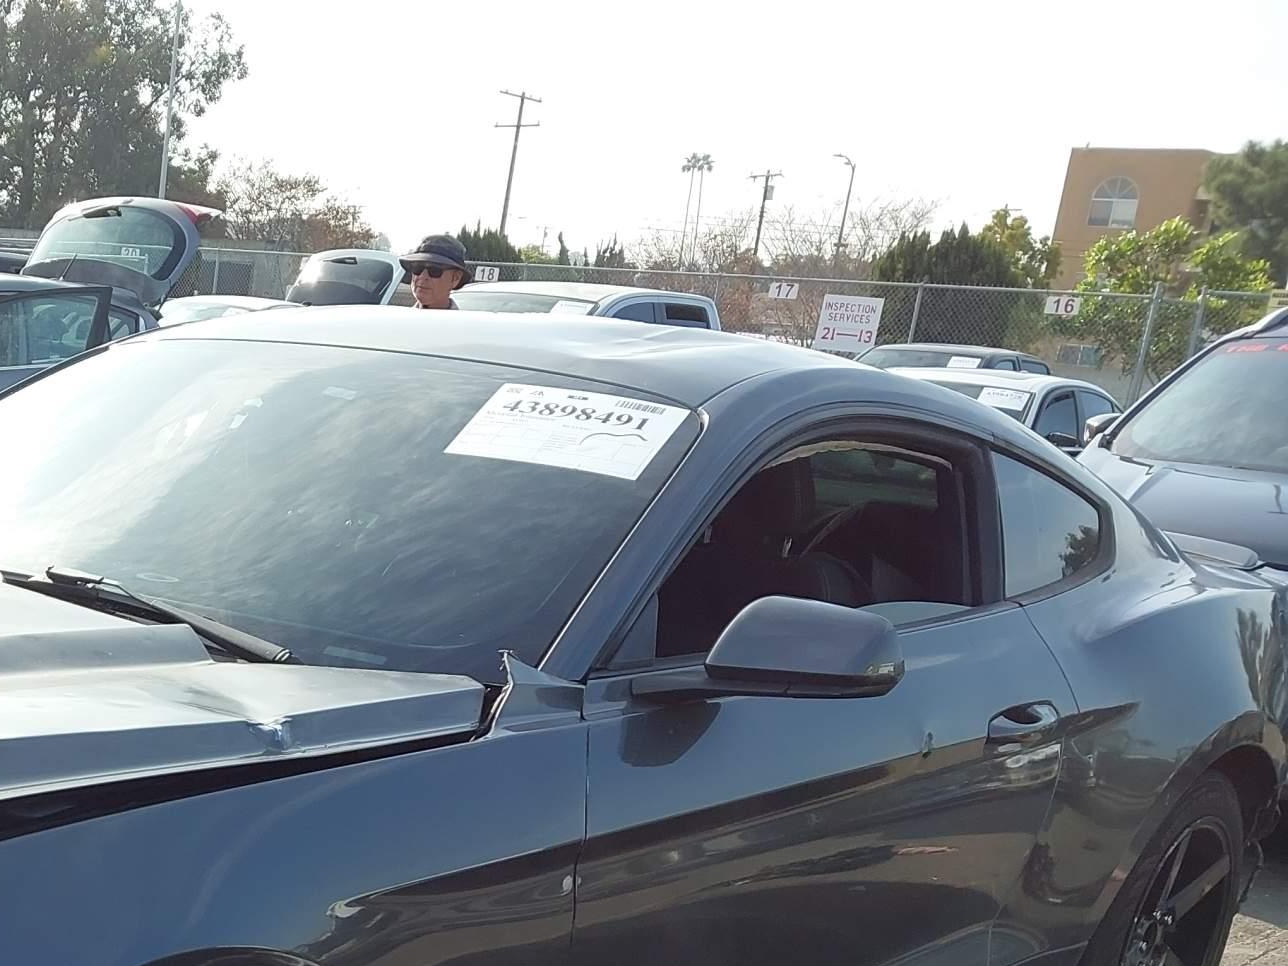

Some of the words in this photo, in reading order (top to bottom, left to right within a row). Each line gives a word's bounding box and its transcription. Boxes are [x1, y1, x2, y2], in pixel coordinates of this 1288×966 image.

[480, 267, 495, 281] 18
[775, 283, 795, 298] 17
[824, 301, 878, 315] INSPECTION
[1053, 298, 1076, 314] 16
[827, 312, 871, 325] SERVICES
[502, 399, 651, 431] 43898491
